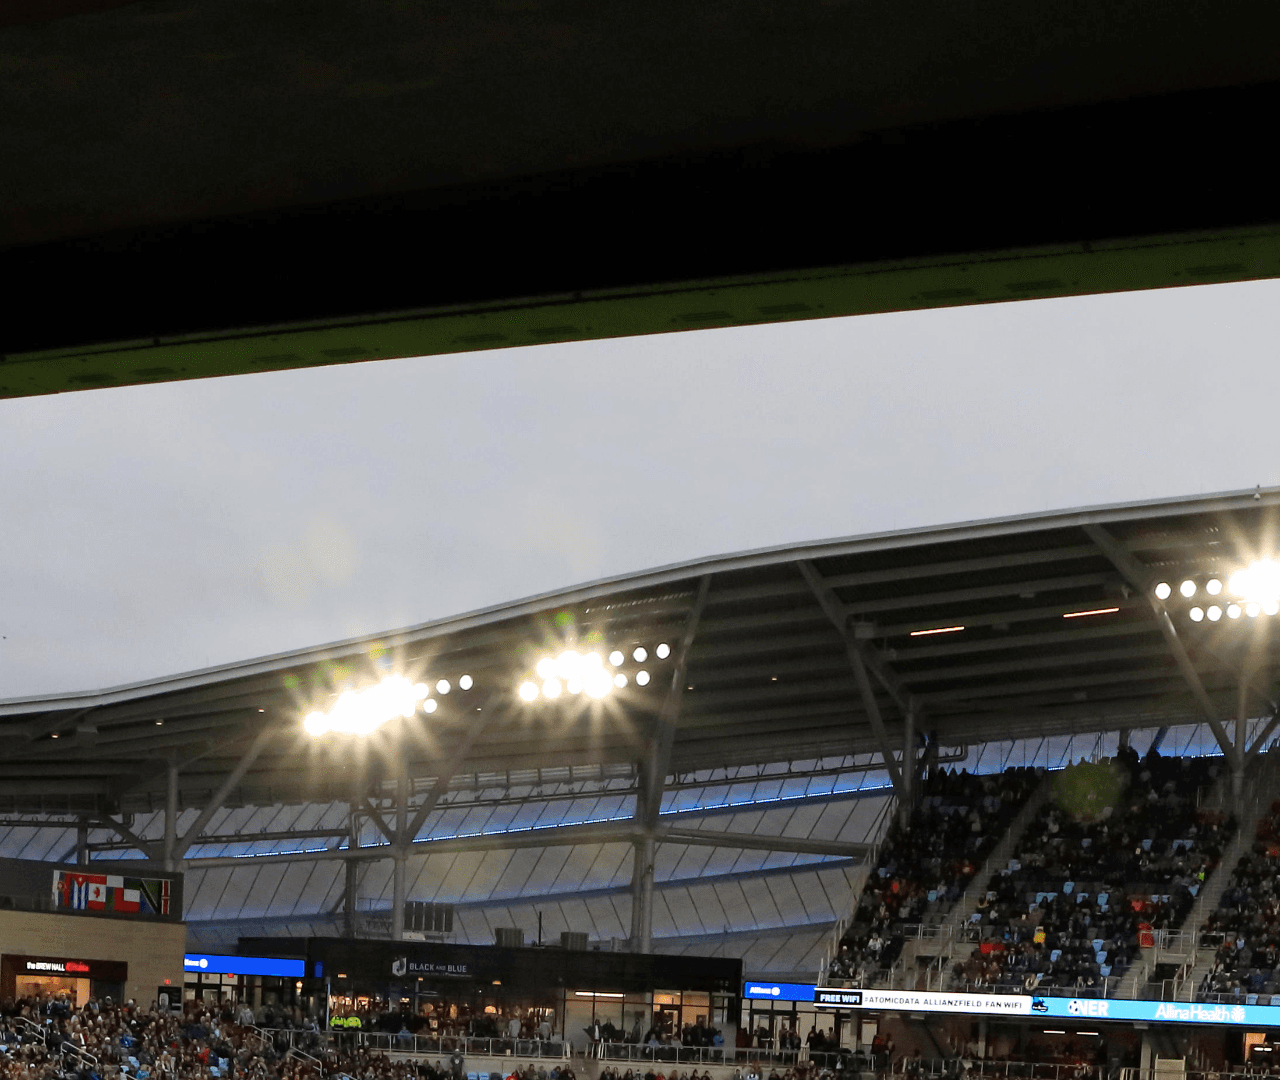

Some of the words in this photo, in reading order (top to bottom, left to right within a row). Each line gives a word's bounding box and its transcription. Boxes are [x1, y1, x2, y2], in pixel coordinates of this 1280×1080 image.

[409, 963, 435, 971] BLACK
[447, 964, 467, 973] BLUE
[820, 993, 840, 1003] FREE
[923, 998, 982, 1008] ALLIANZFIELD
[985, 1000, 1002, 1009] FAN
[1004, 1001, 1022, 1010] WIFI
